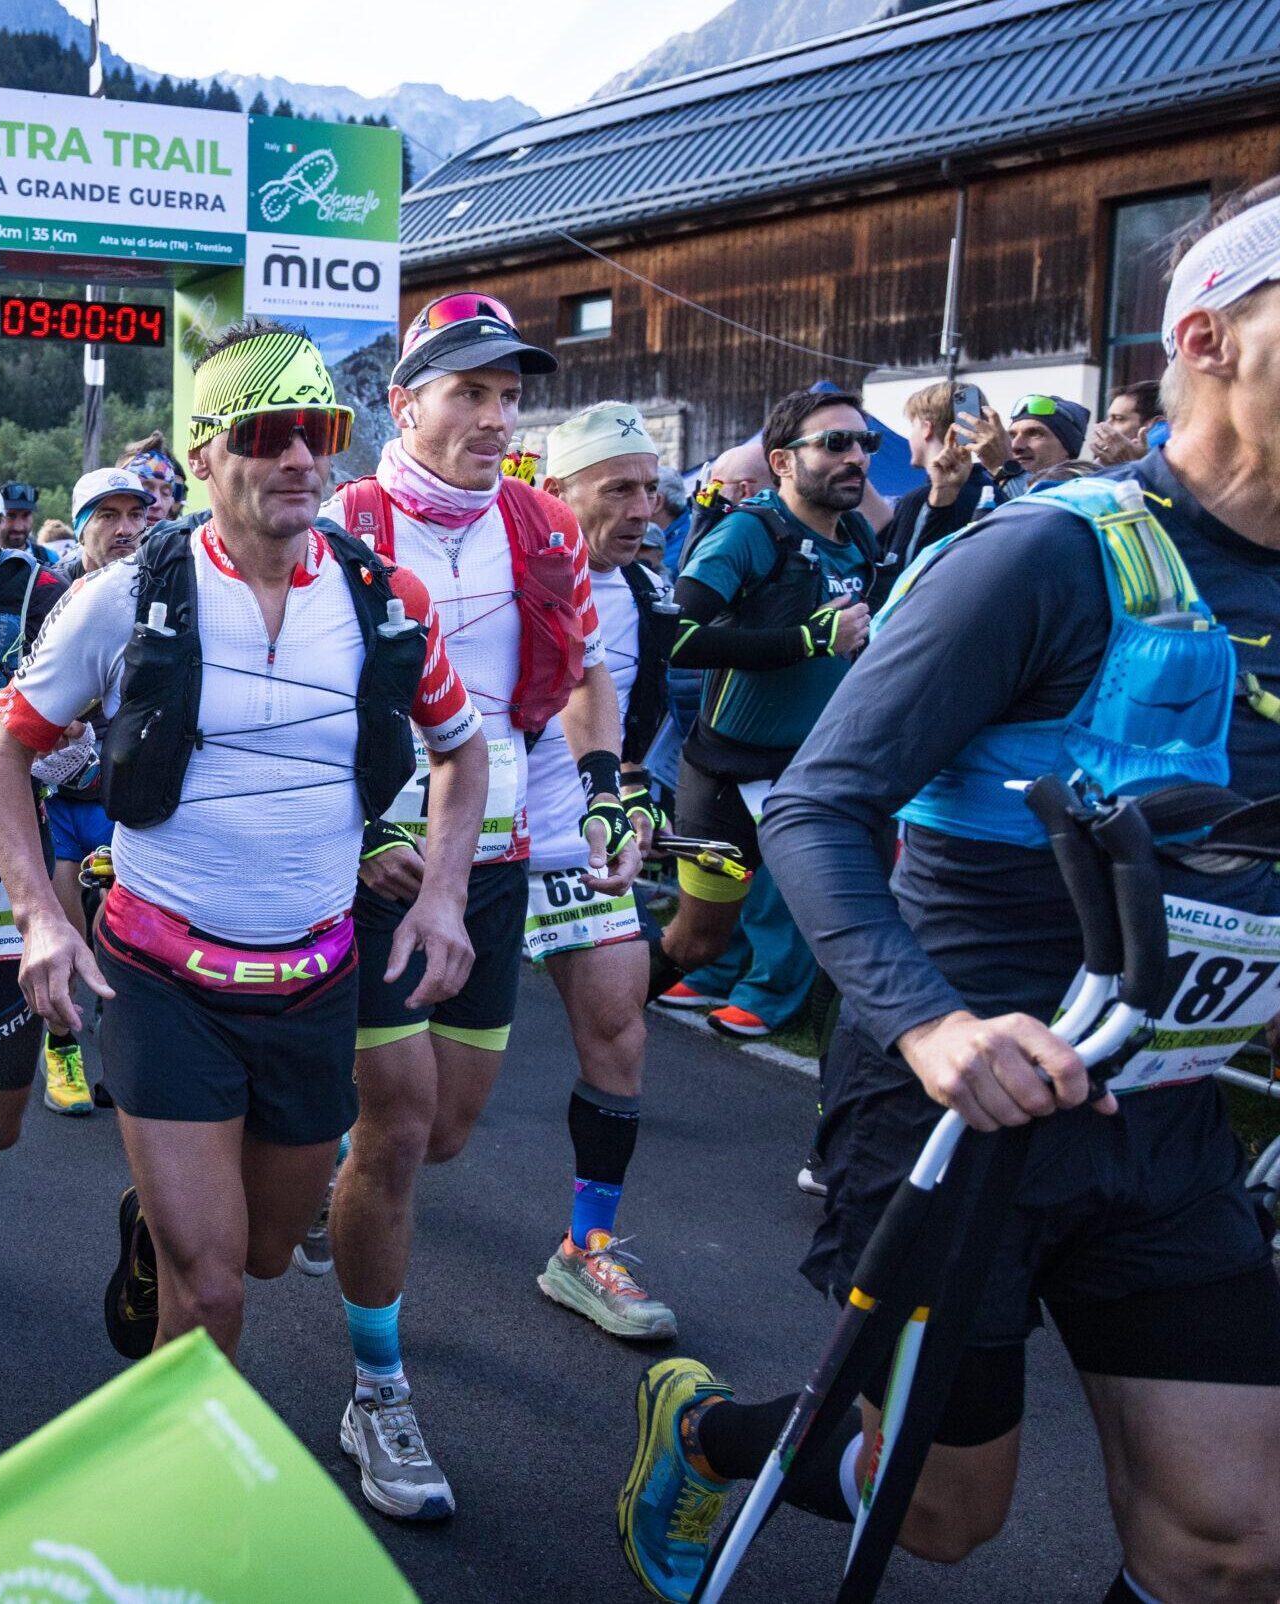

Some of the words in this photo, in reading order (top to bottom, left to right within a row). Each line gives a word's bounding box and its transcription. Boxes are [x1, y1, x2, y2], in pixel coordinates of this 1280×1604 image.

[104, 130, 232, 176] TRAIL
[264, 142, 281, 153] Italy
[16, 178, 120, 204] GRANDE
[130, 187, 226, 213] GUERRA
[32, 227, 50, 241] 35
[53, 228, 77, 243] Km
[99, 234, 119, 246] Alta
[121, 236, 136, 247] Val
[137, 237, 146, 248] di
[148, 238, 168, 250] Sole
[169, 239, 188, 252] (TN)
[194, 241, 233, 254] Trentino
[3, 299, 160, 342] 09:00:04
[437, 719, 469, 742] BORN
[543, 867, 595, 908] 63
[540, 909, 580, 927] BERTONI
[581, 902, 613, 917] MIRCO
[186, 949, 328, 984] LEKI
